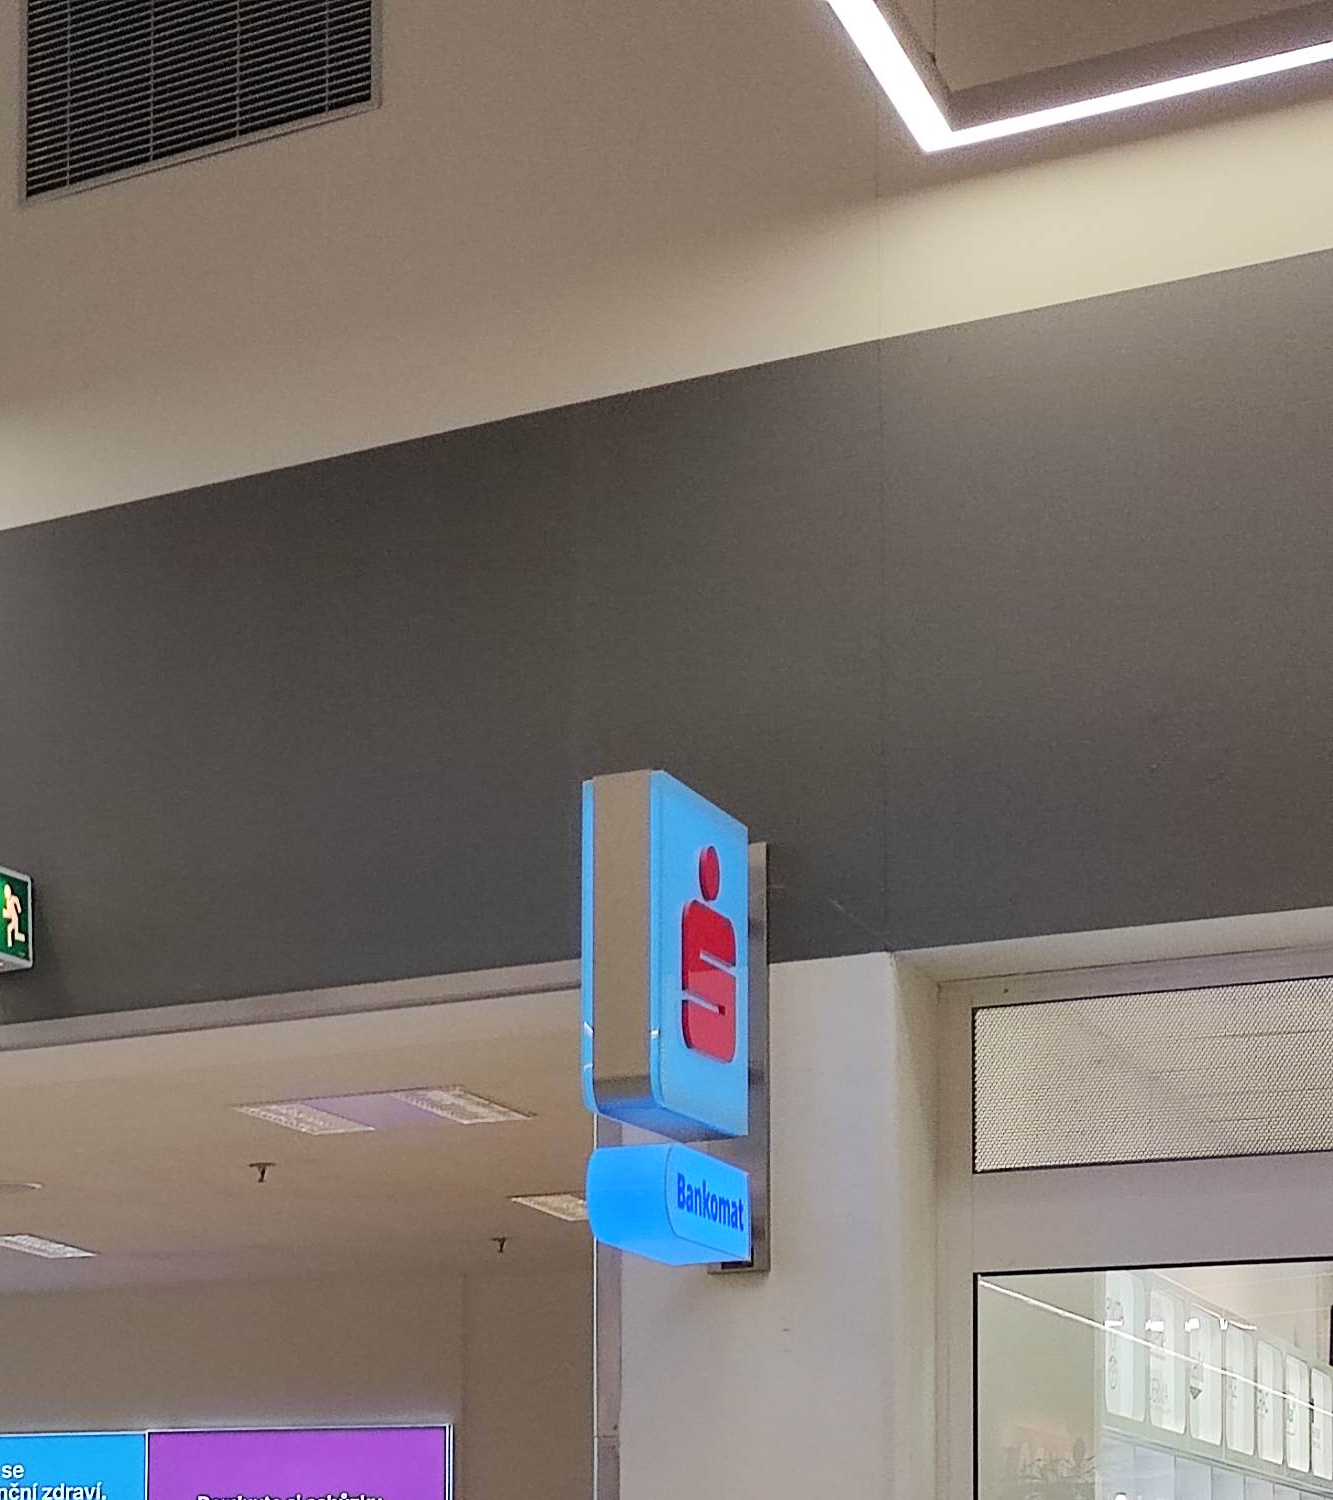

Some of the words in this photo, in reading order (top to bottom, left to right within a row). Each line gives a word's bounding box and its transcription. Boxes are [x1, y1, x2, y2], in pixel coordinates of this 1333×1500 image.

[677, 1172, 745, 1232] Bankomat
[2, 1465, 25, 1479] se
[42, 1482, 107, 1500] zdraví.
